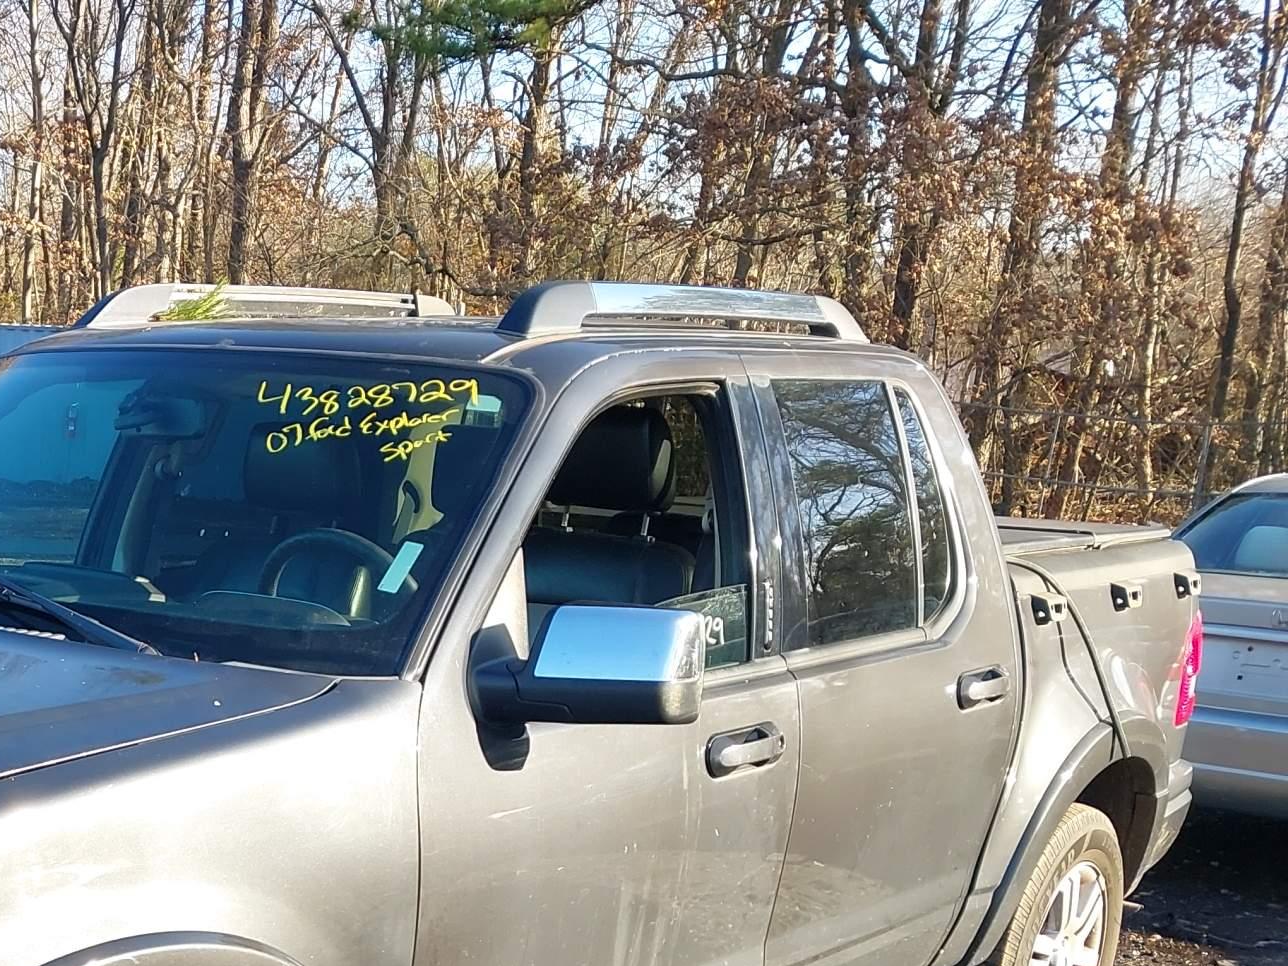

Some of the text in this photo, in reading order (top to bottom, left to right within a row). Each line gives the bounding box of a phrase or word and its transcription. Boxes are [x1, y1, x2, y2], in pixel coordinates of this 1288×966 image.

[257, 377, 480, 415] 43828729
[266, 422, 302, 453] 07
[704, 615, 724, 645] 29
